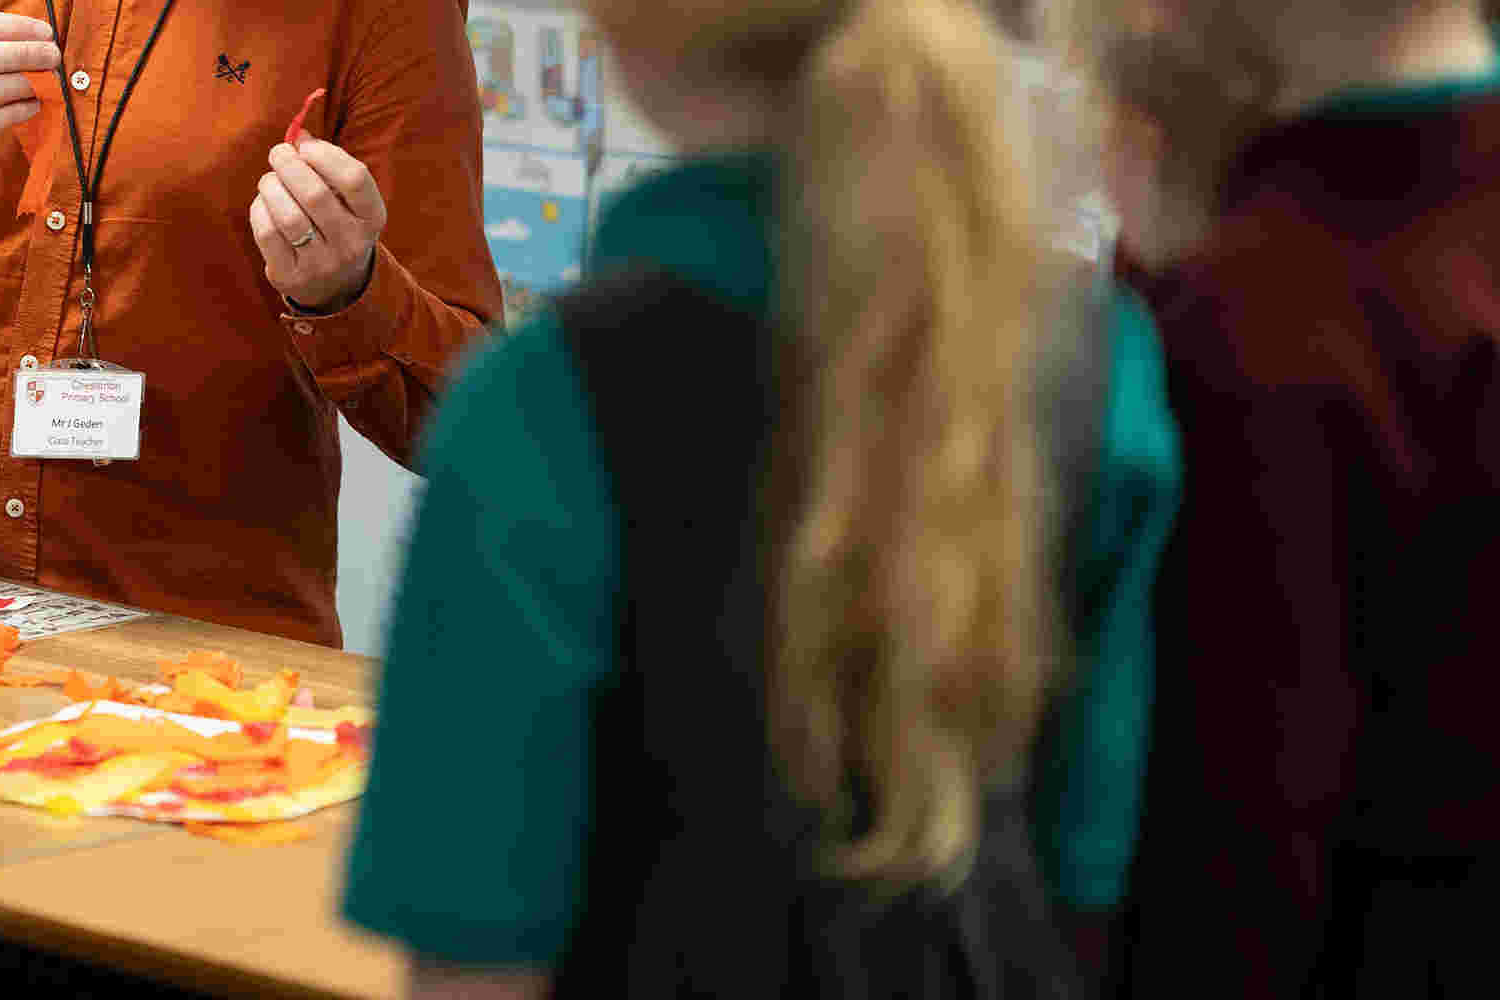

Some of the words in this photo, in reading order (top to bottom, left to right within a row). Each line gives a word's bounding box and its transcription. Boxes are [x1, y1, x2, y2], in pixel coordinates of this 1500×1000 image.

[60, 391, 95, 404] Primary
[98, 391, 131, 403] School
[51, 418, 65, 429] Mr
